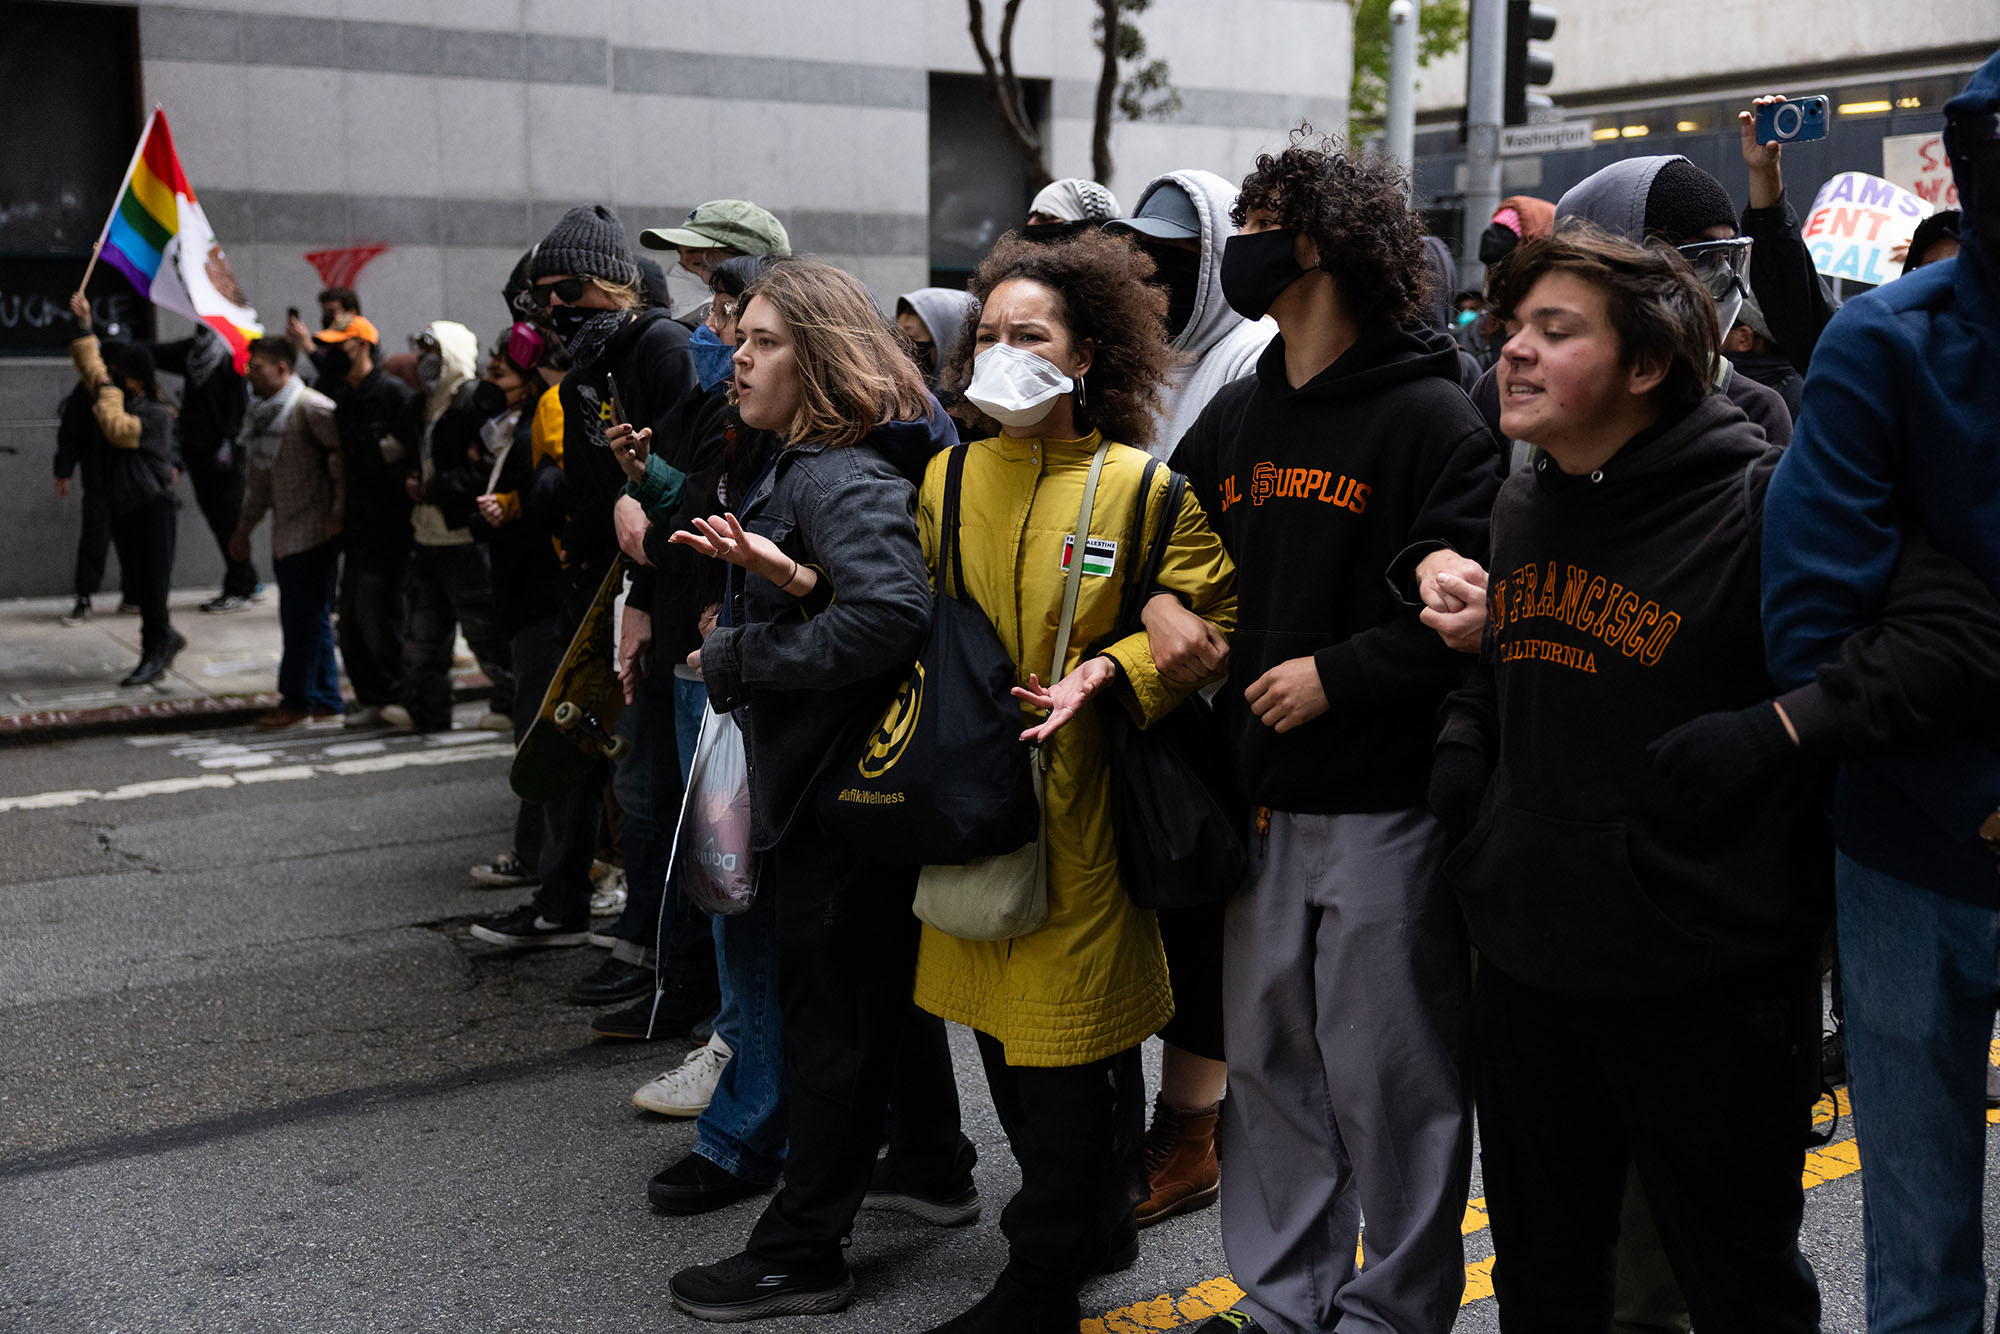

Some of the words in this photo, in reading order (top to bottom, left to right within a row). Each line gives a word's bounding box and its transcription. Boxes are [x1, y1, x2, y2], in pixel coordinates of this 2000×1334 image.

[1505, 129, 1584, 149] Washington
[1086, 541, 1115, 549] ALESTINE
[1510, 560, 1682, 668] FRANCISCO
[1500, 638, 1598, 674] CALIFORNIA
